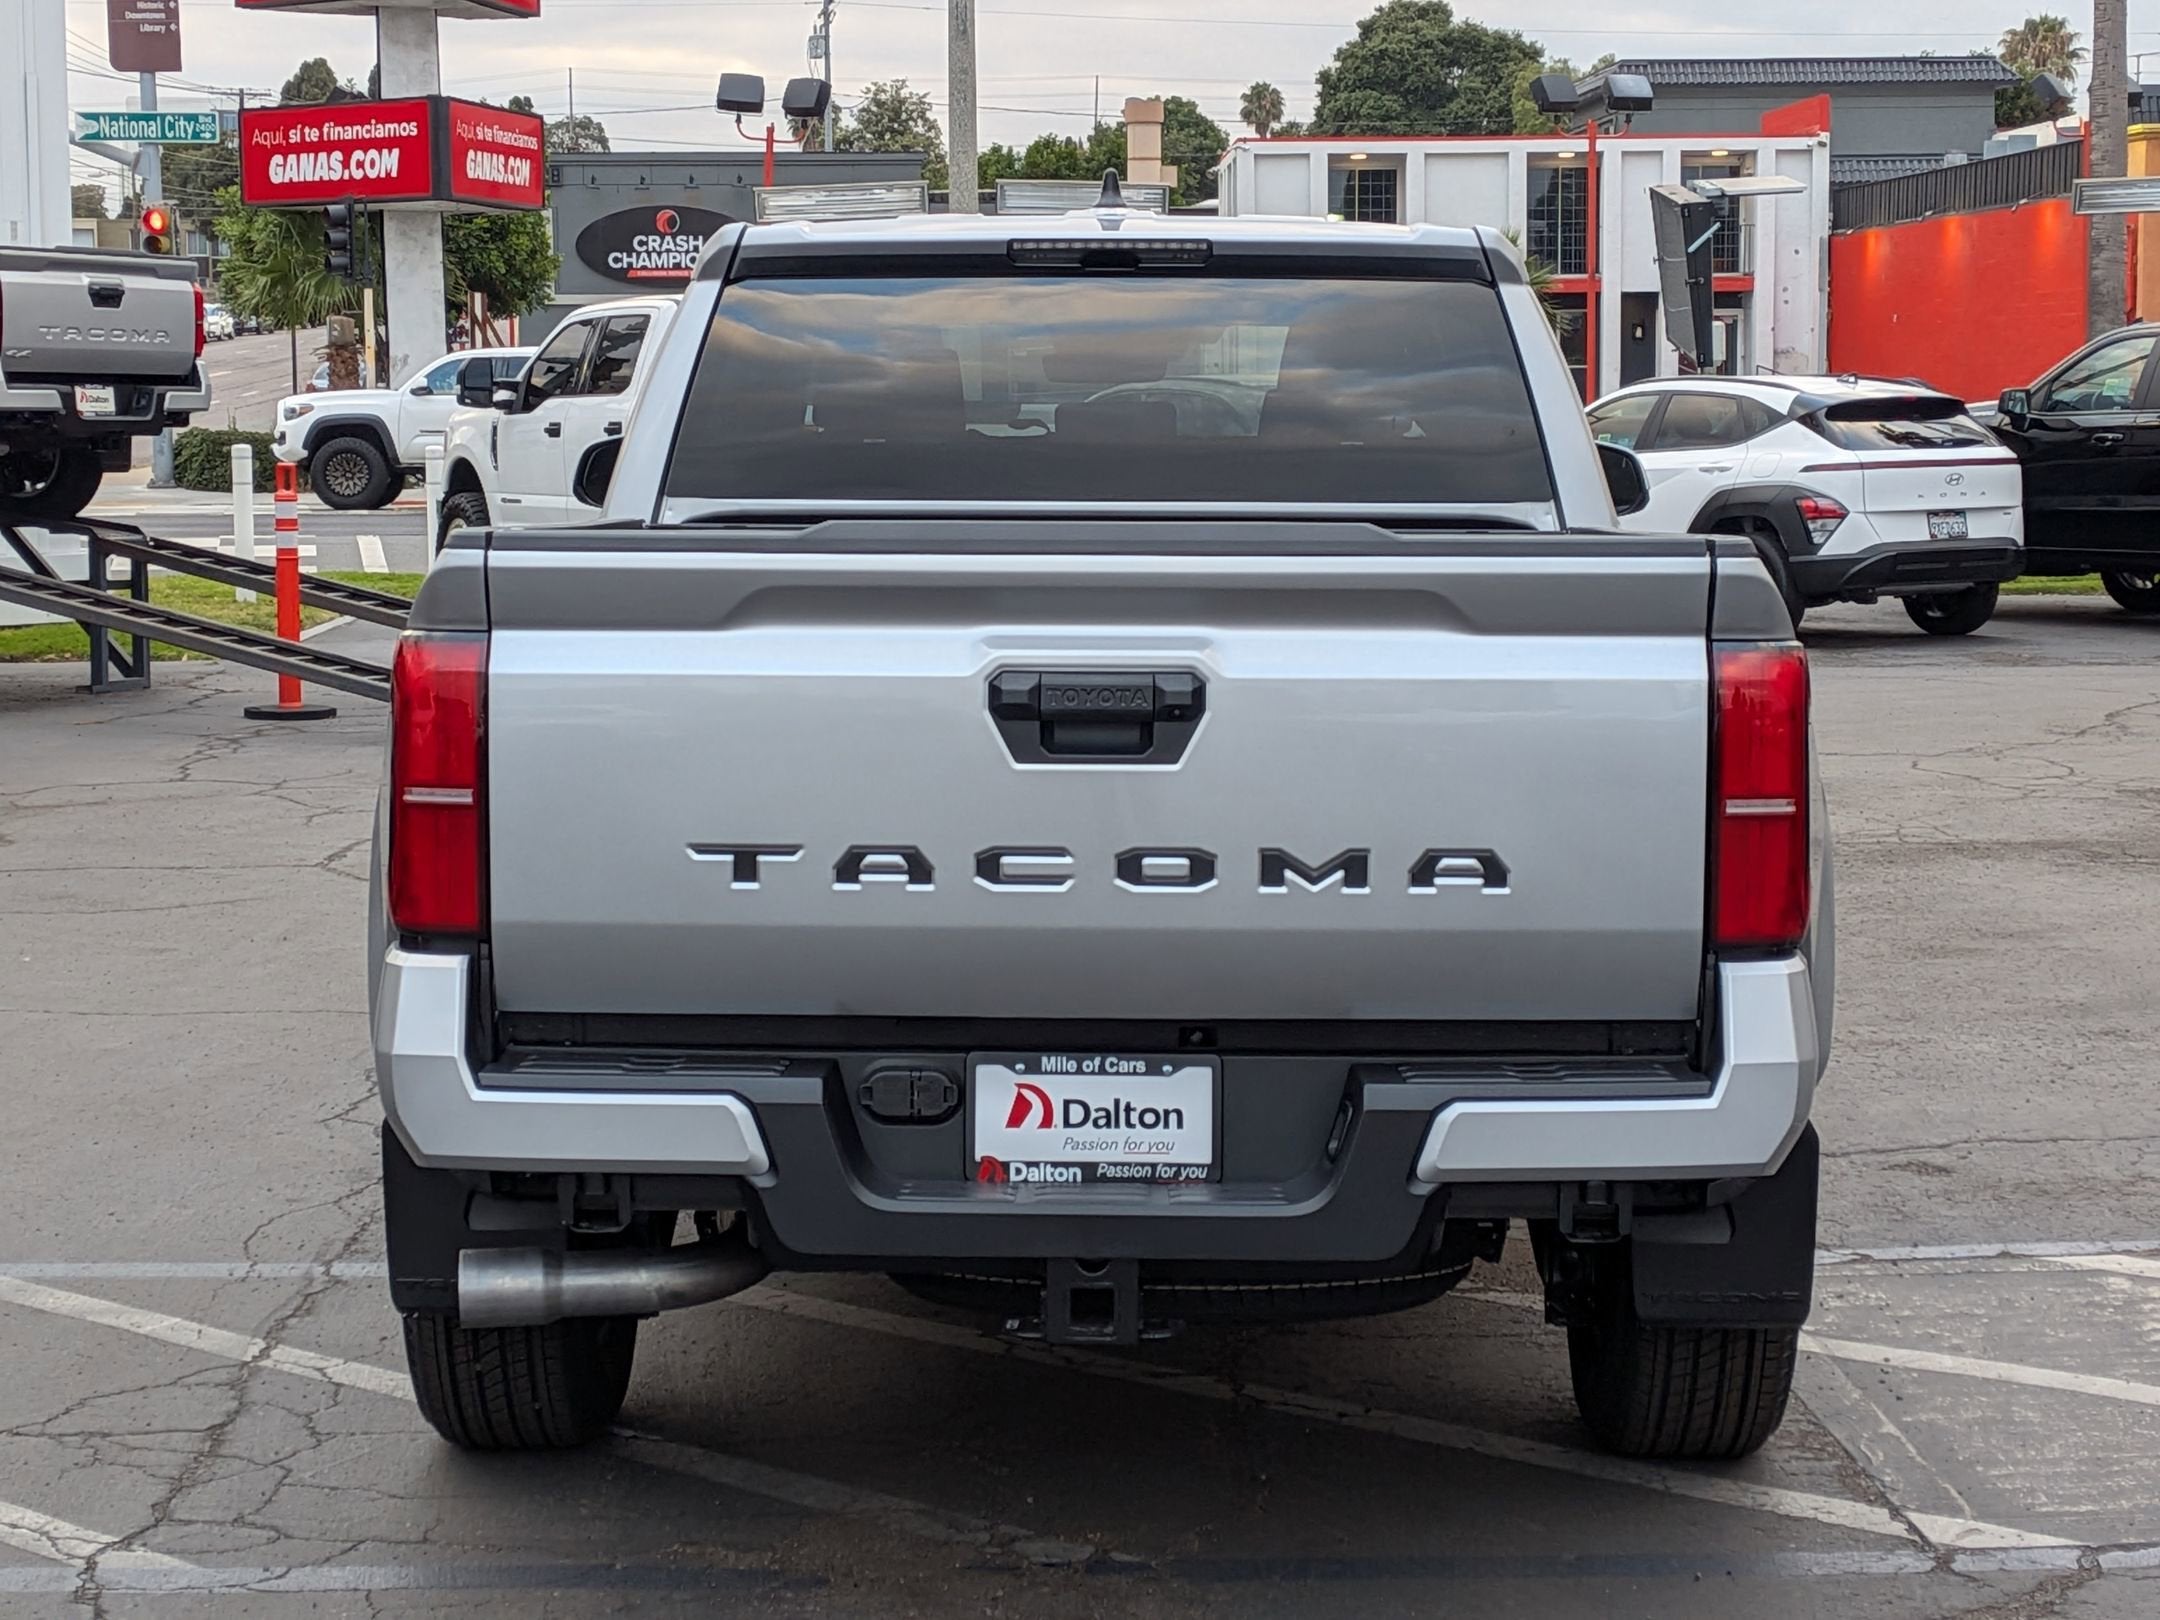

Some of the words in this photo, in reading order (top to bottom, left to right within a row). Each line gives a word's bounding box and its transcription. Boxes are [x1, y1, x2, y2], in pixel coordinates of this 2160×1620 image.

[124, 11, 166, 19] Downtown
[139, 23, 166, 34] Library
[100, 115, 162, 139] National
[164, 116, 195, 140] City
[252, 125, 286, 149] Aquí,
[288, 124, 302, 144] sí
[304, 125, 319, 142] te
[322, 119, 418, 142] financiamos
[484, 124, 493, 142] te
[493, 124, 538, 151] financiamos
[268, 147, 400, 184] GANAS.COM
[466, 148, 531, 187] GANAS.COM
[632, 235, 703, 252] CRASH
[38, 325, 171, 344] TACOMA
[1045, 687, 1149, 707] TOYOTA
[685, 843, 1511, 894] TACOMA
[1041, 1056, 1077, 1073] Mile
[1082, 1056, 1101, 1073] of
[1105, 1057, 1147, 1073] Cars
[1062, 1098, 1184, 1130] Dalton
[1062, 1136, 1118, 1151] Passion
[1122, 1136, 1145, 1152] for
[1146, 1140, 1175, 1152] you
[1009, 1162, 1082, 1183] Dalton
[1097, 1163, 1151, 1179] Passion
[1155, 1164, 1178, 1180] for
[1178, 1166, 1208, 1181] you
